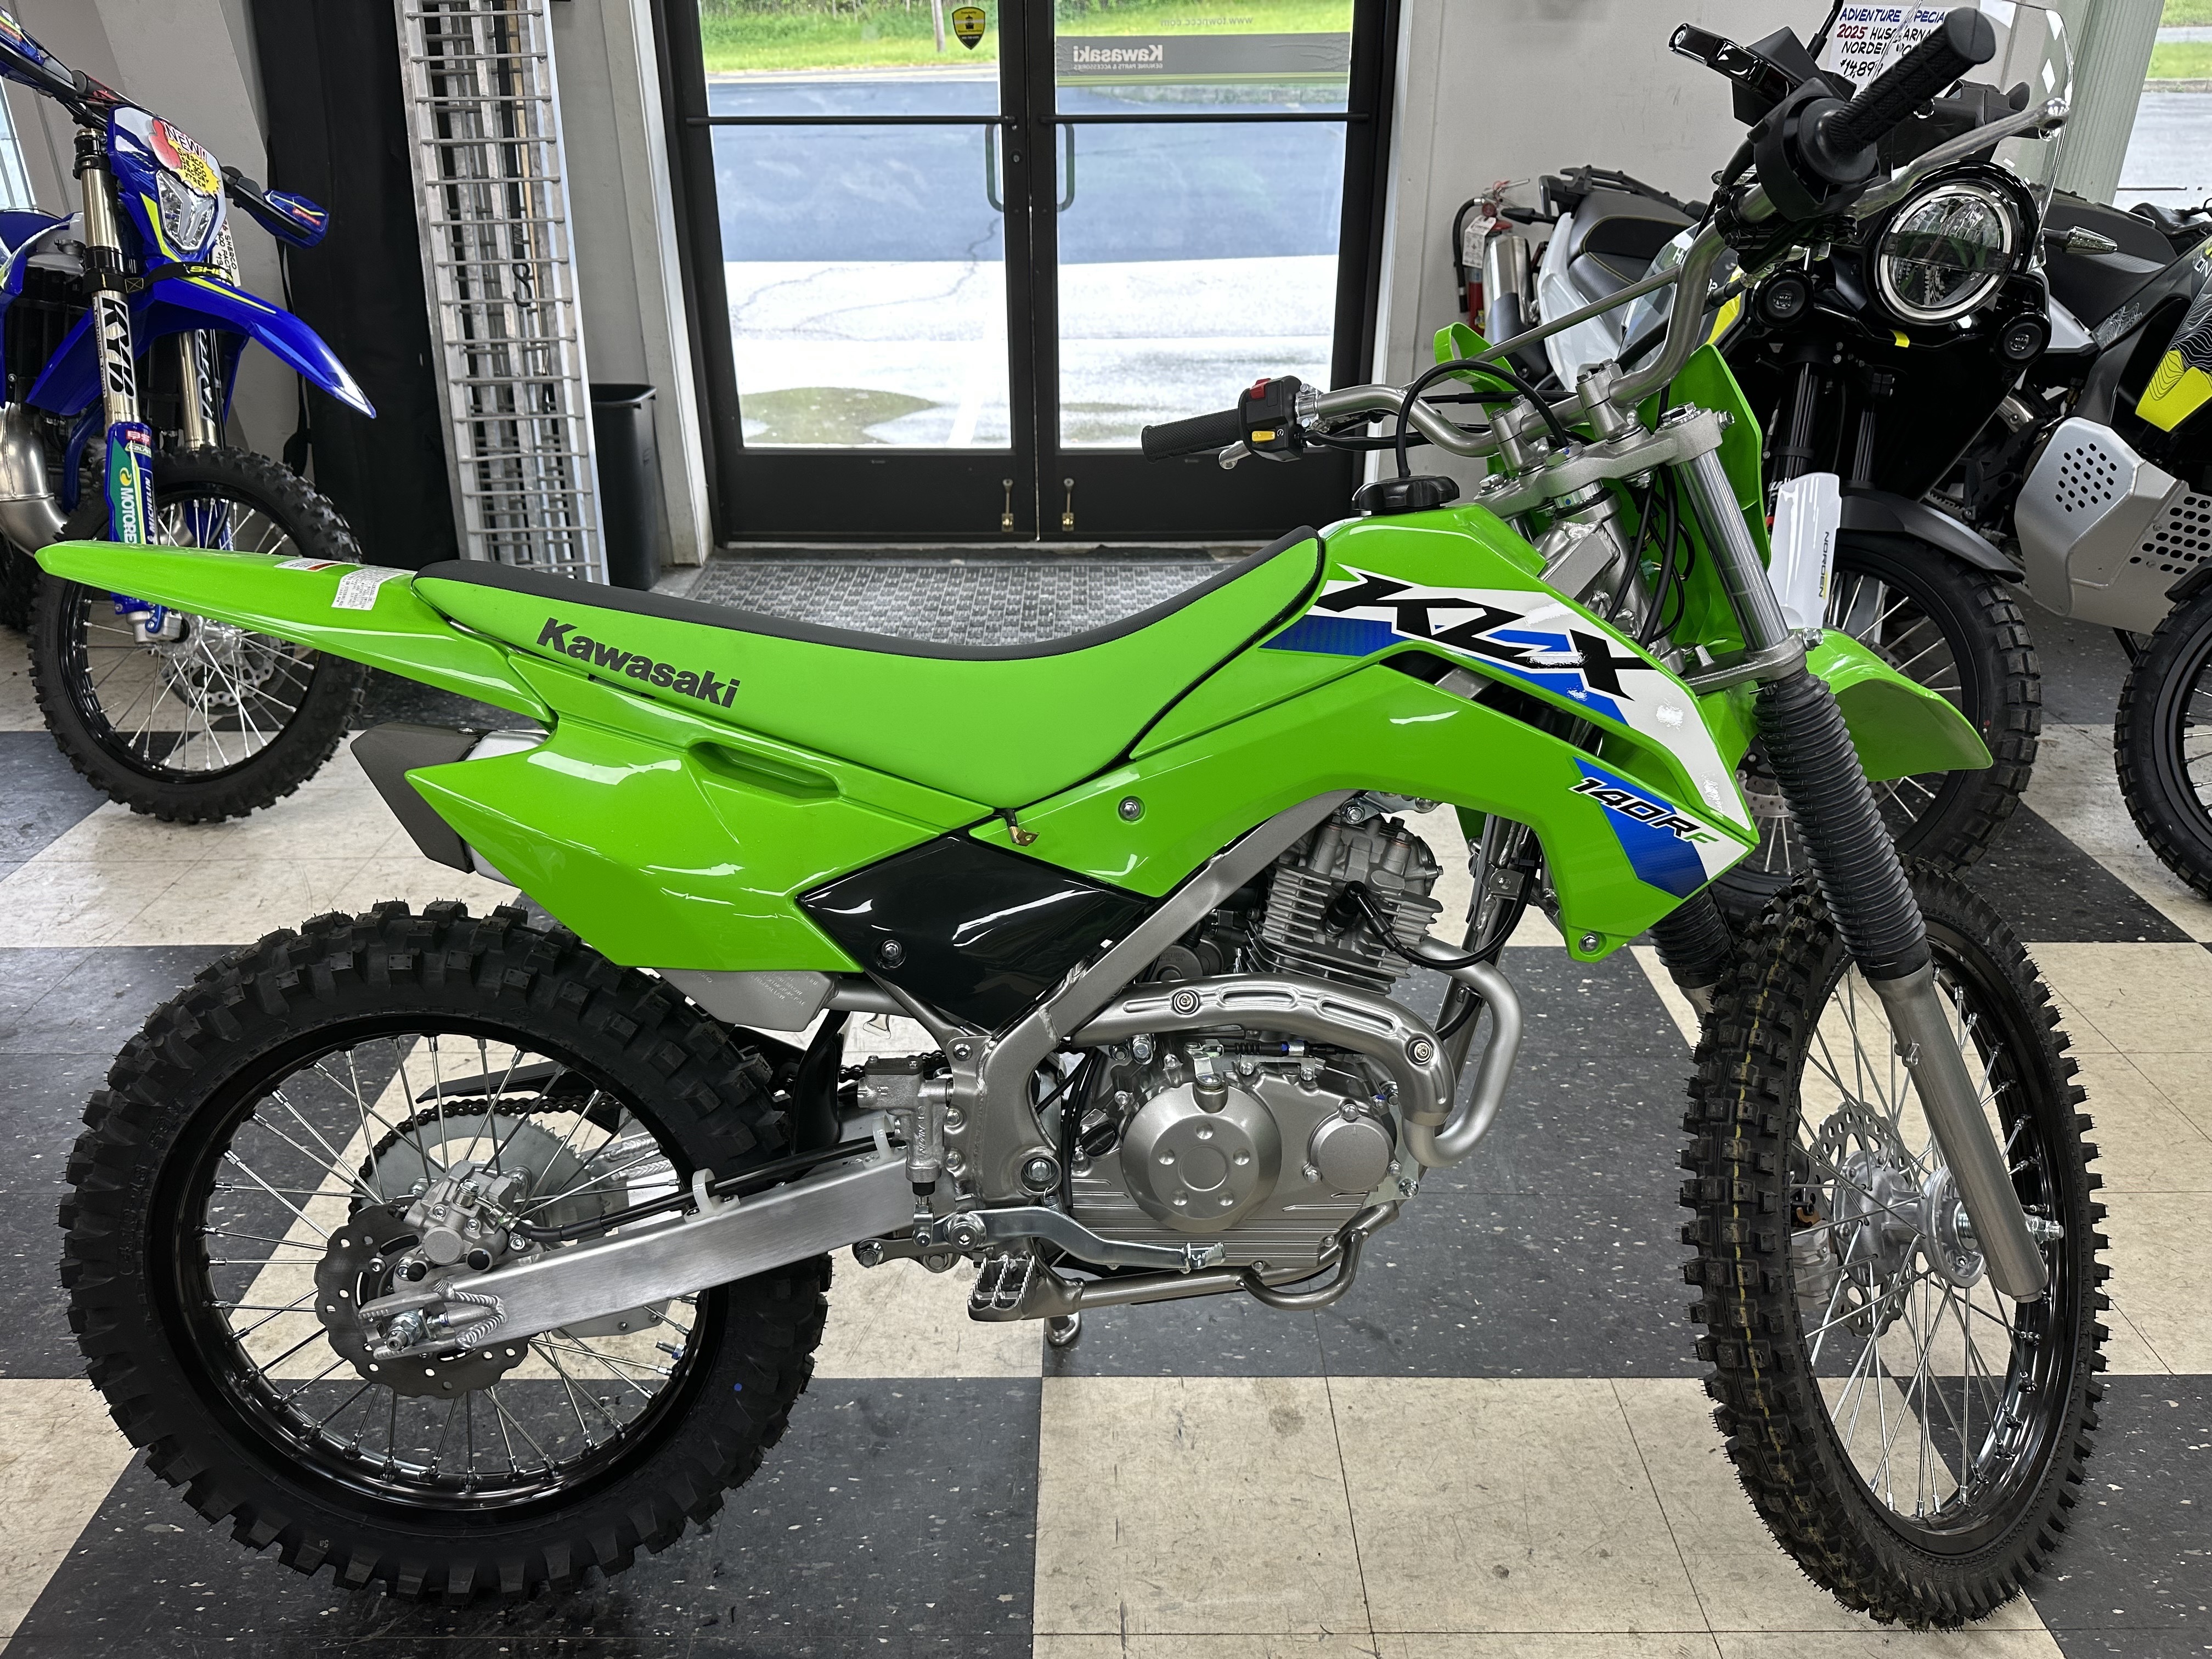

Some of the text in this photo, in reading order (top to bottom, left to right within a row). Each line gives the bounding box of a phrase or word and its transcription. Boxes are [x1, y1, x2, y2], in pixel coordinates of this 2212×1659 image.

[1837, 24, 1868, 40] 2025
[1839, 8, 1945, 24] ADVENTURE PECIA
[164, 123, 206, 161] NEW!
[178, 147, 204, 169] SHERCO
[225, 234, 237, 269] SHERCO
[101, 296, 136, 399] KYB
[145, 477, 156, 533] MICHELIN
[1819, 531, 1830, 597] NORDEN
[536, 617, 740, 709] Kawasaki
